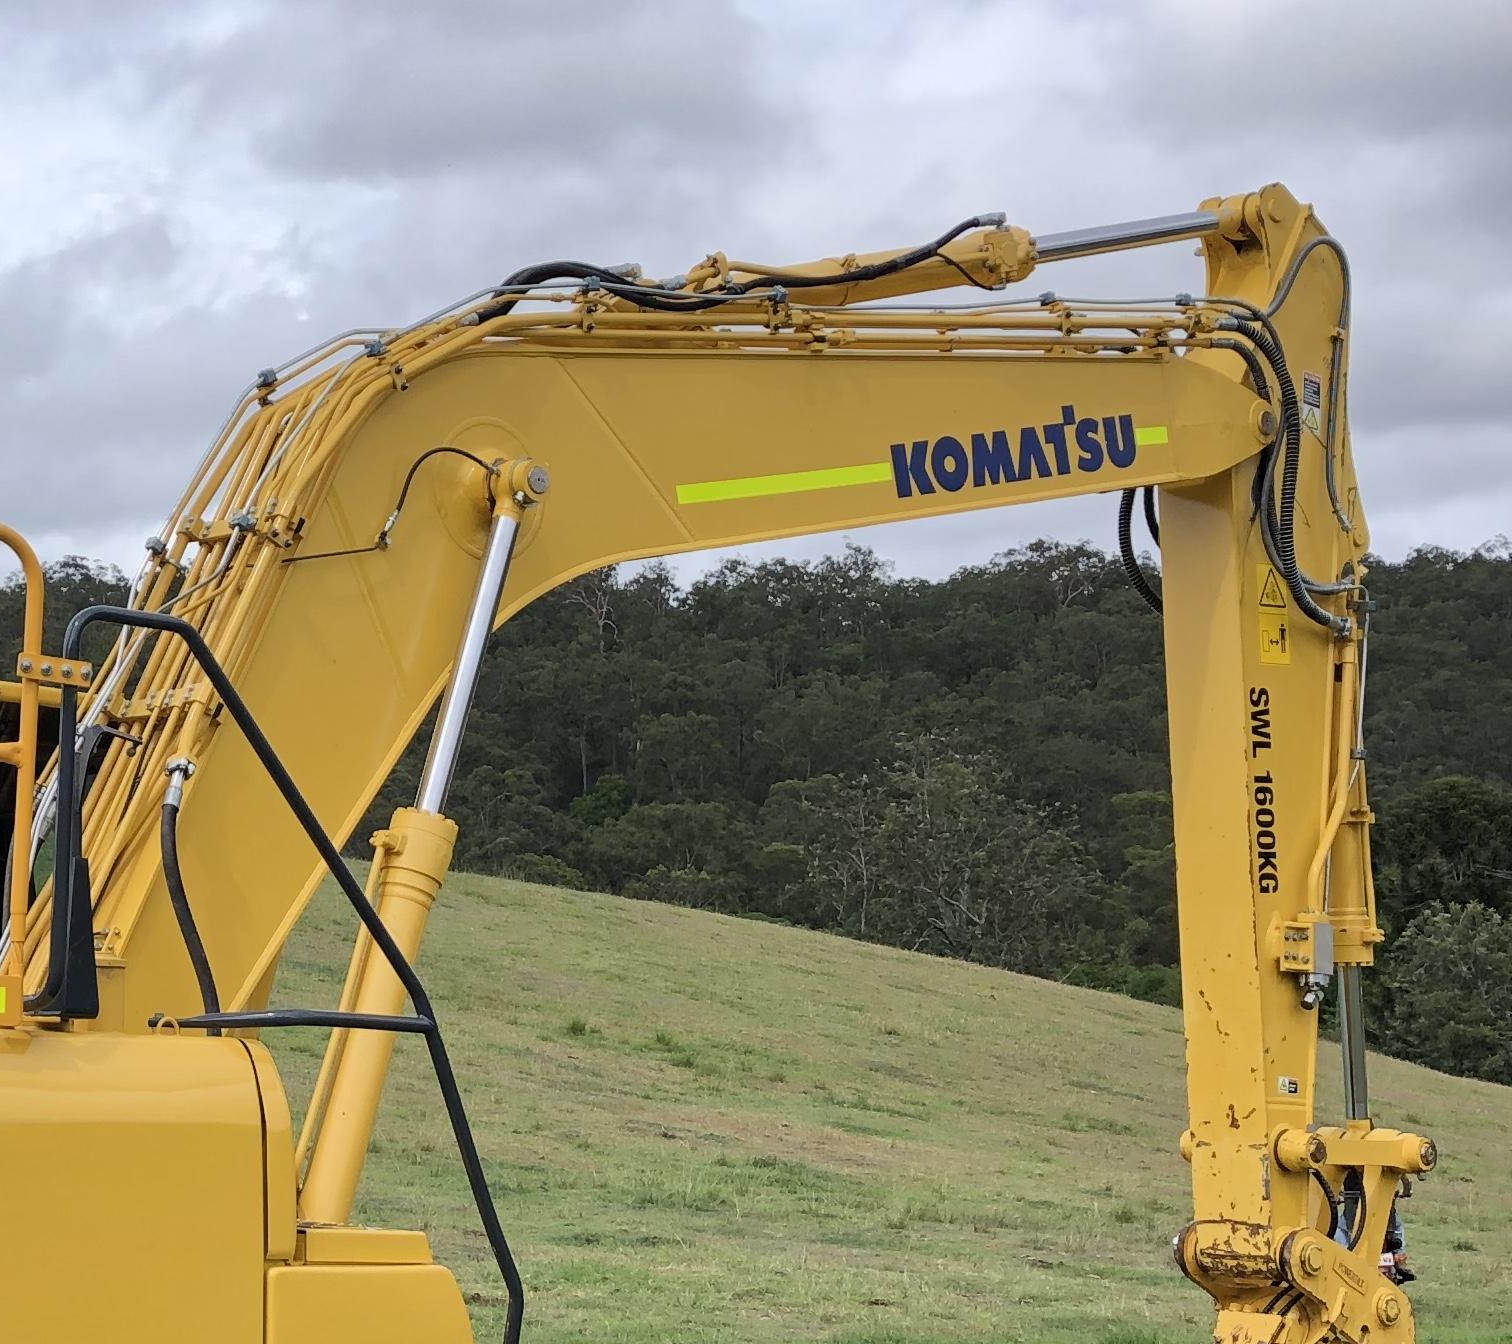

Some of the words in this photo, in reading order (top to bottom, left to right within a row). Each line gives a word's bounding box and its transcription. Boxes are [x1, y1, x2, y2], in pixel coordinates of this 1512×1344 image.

[890, 405, 1136, 498] KOMATSU
[1249, 687, 1271, 758] SWL
[1253, 770, 1279, 894] 1600KG
